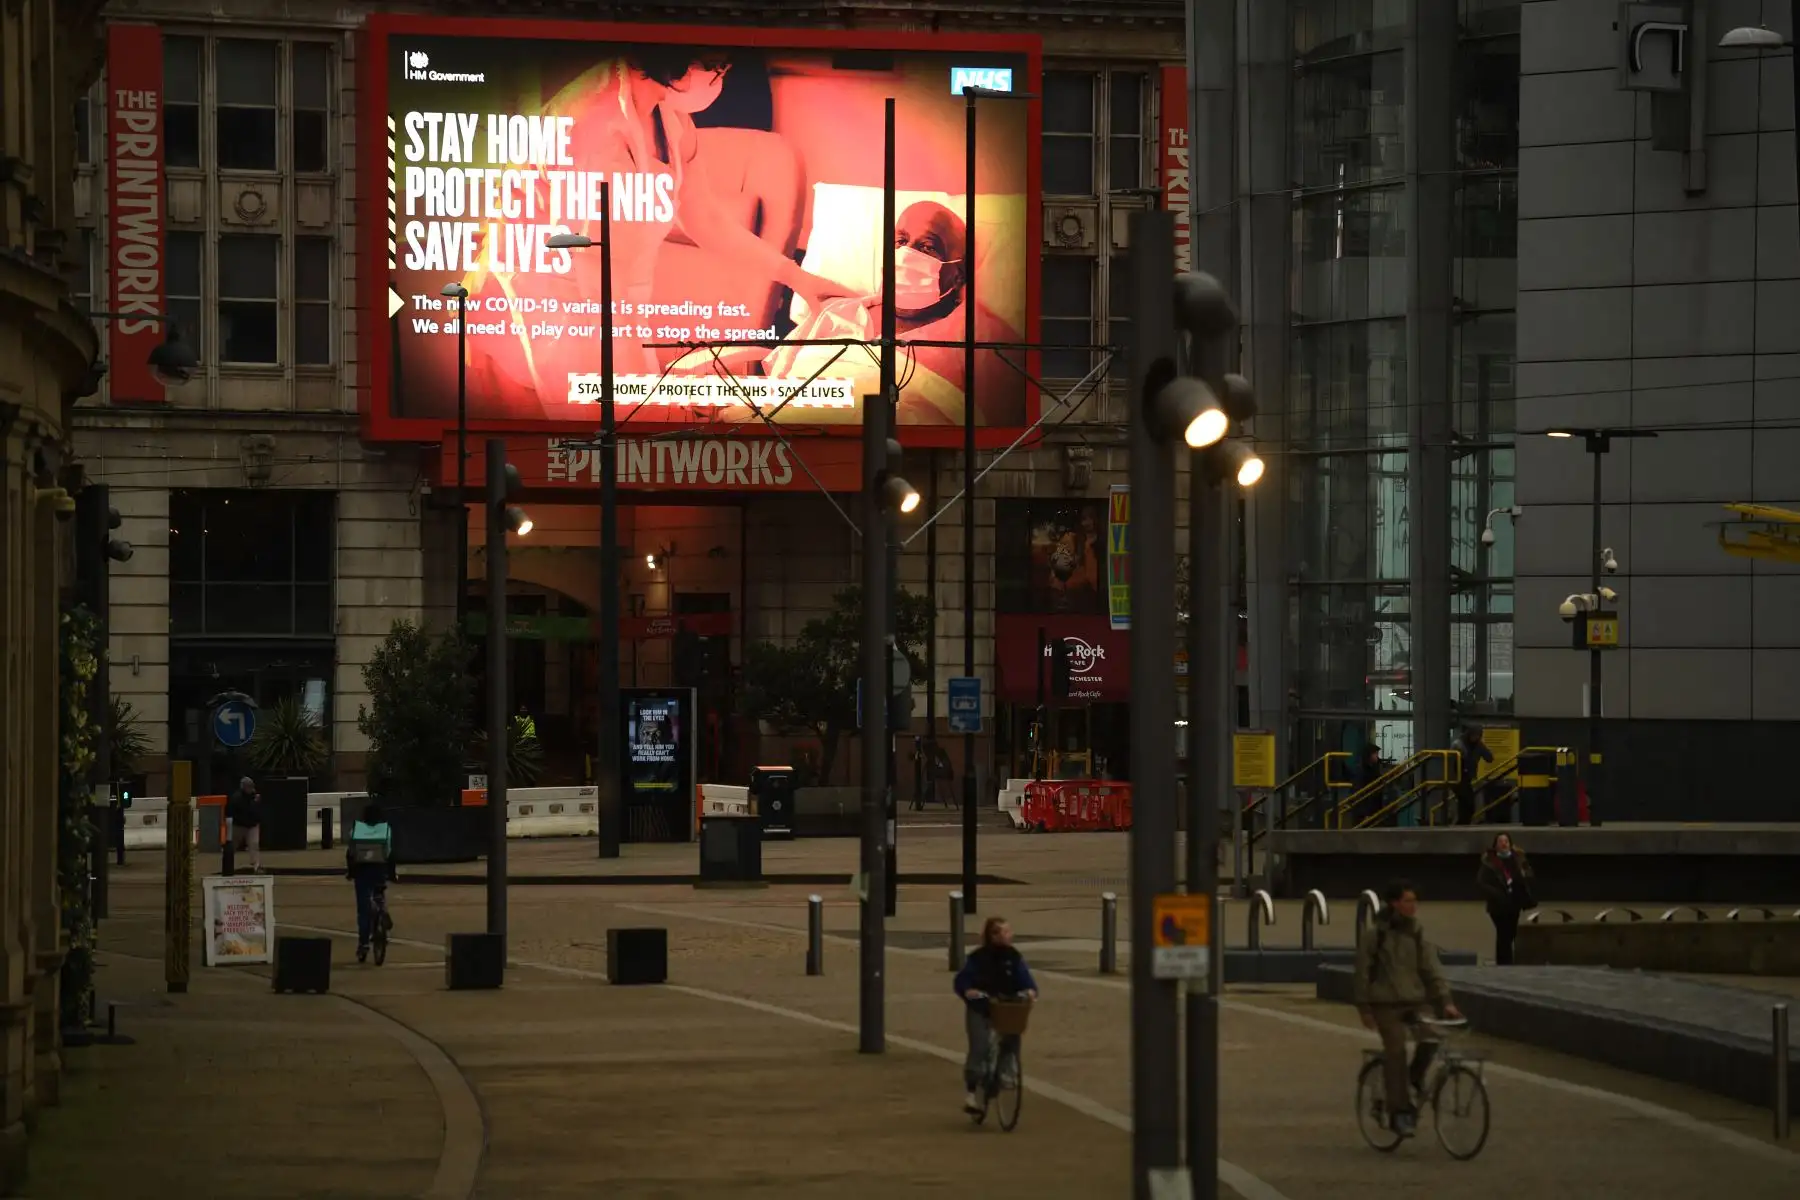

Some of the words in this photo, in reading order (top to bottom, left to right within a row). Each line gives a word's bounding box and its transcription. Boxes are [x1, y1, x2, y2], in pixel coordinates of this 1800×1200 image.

[409, 70, 427, 80] HM
[428, 71, 485, 82] Government
[953, 70, 1009, 92] NHS
[115, 90, 157, 109] THE
[405, 112, 478, 162] STAY
[487, 114, 574, 166] HOME
[405, 167, 544, 219] PROTECT
[548, 171, 601, 221] THE
[613, 173, 674, 223] NHS
[116, 110, 160, 334] PRINTWORKS
[405, 221, 480, 271] SAVE
[489, 224, 573, 273] LIVES
[412, 294, 442, 311] The
[485, 297, 558, 313] COVID-19
[562, 299, 616, 315] variat
[620, 300, 633, 315] is
[637, 301, 713, 318] spreading
[717, 301, 751, 317] fast.
[412, 319, 439, 333] We
[443, 318, 460, 334] all
[467, 320, 505, 335] need
[510, 322, 524, 335] to
[531, 321, 563, 339] play
[568, 325, 595, 337] our
[600, 325, 633, 340] art
[636, 325, 652, 338] to
[656, 325, 690, 340] stop
[694, 325, 720, 339] the
[724, 325, 780, 341] spread.
[659, 385, 712, 396] PROTECT
[716, 386, 739, 396] THE
[743, 386, 767, 397] NHS
[777, 386, 808, 398] SAVE
[811, 387, 845, 398] LIVES
[548, 438, 566, 481] THE
[1076, 644, 1106, 660] Rock
